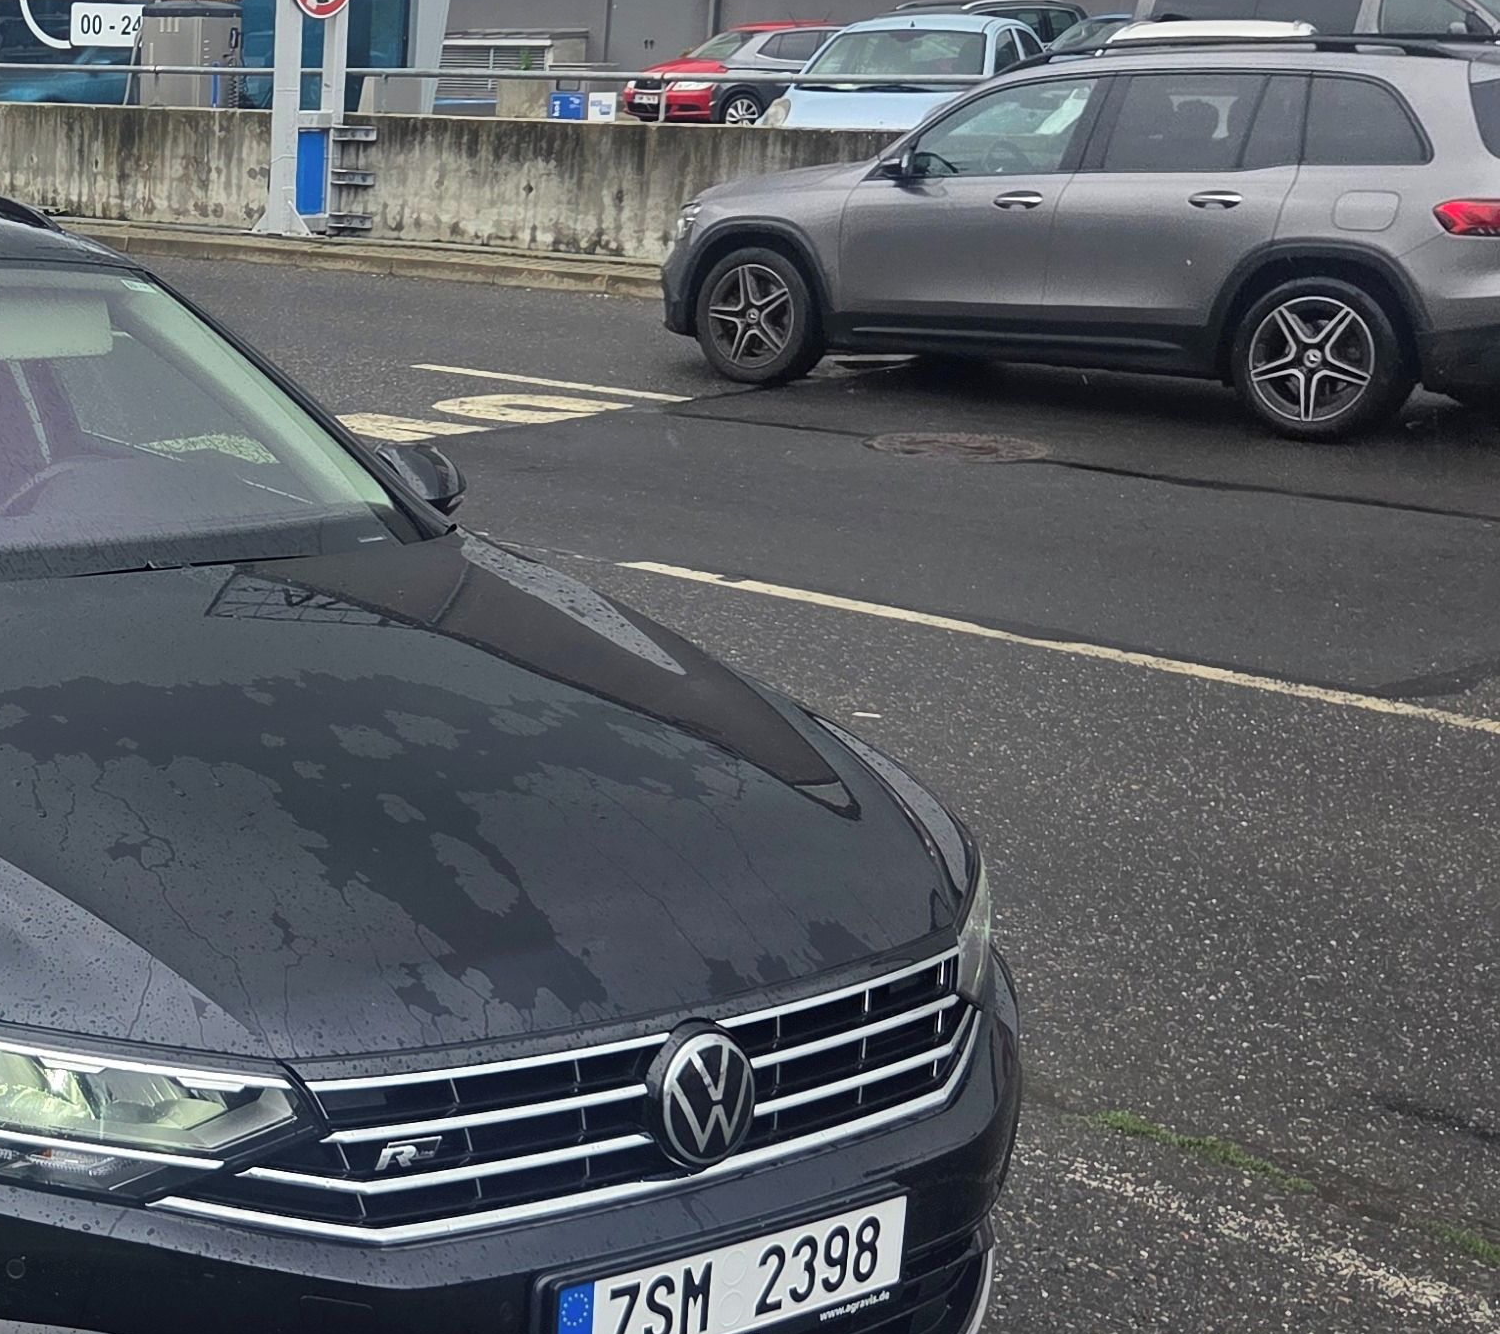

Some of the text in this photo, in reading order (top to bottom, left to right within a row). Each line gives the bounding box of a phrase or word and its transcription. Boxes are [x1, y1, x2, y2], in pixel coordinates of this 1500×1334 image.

[81, 14, 103, 35] 00
[754, 1215, 881, 1317] 2398
[820, 1290, 890, 1321] www.agravis.de
